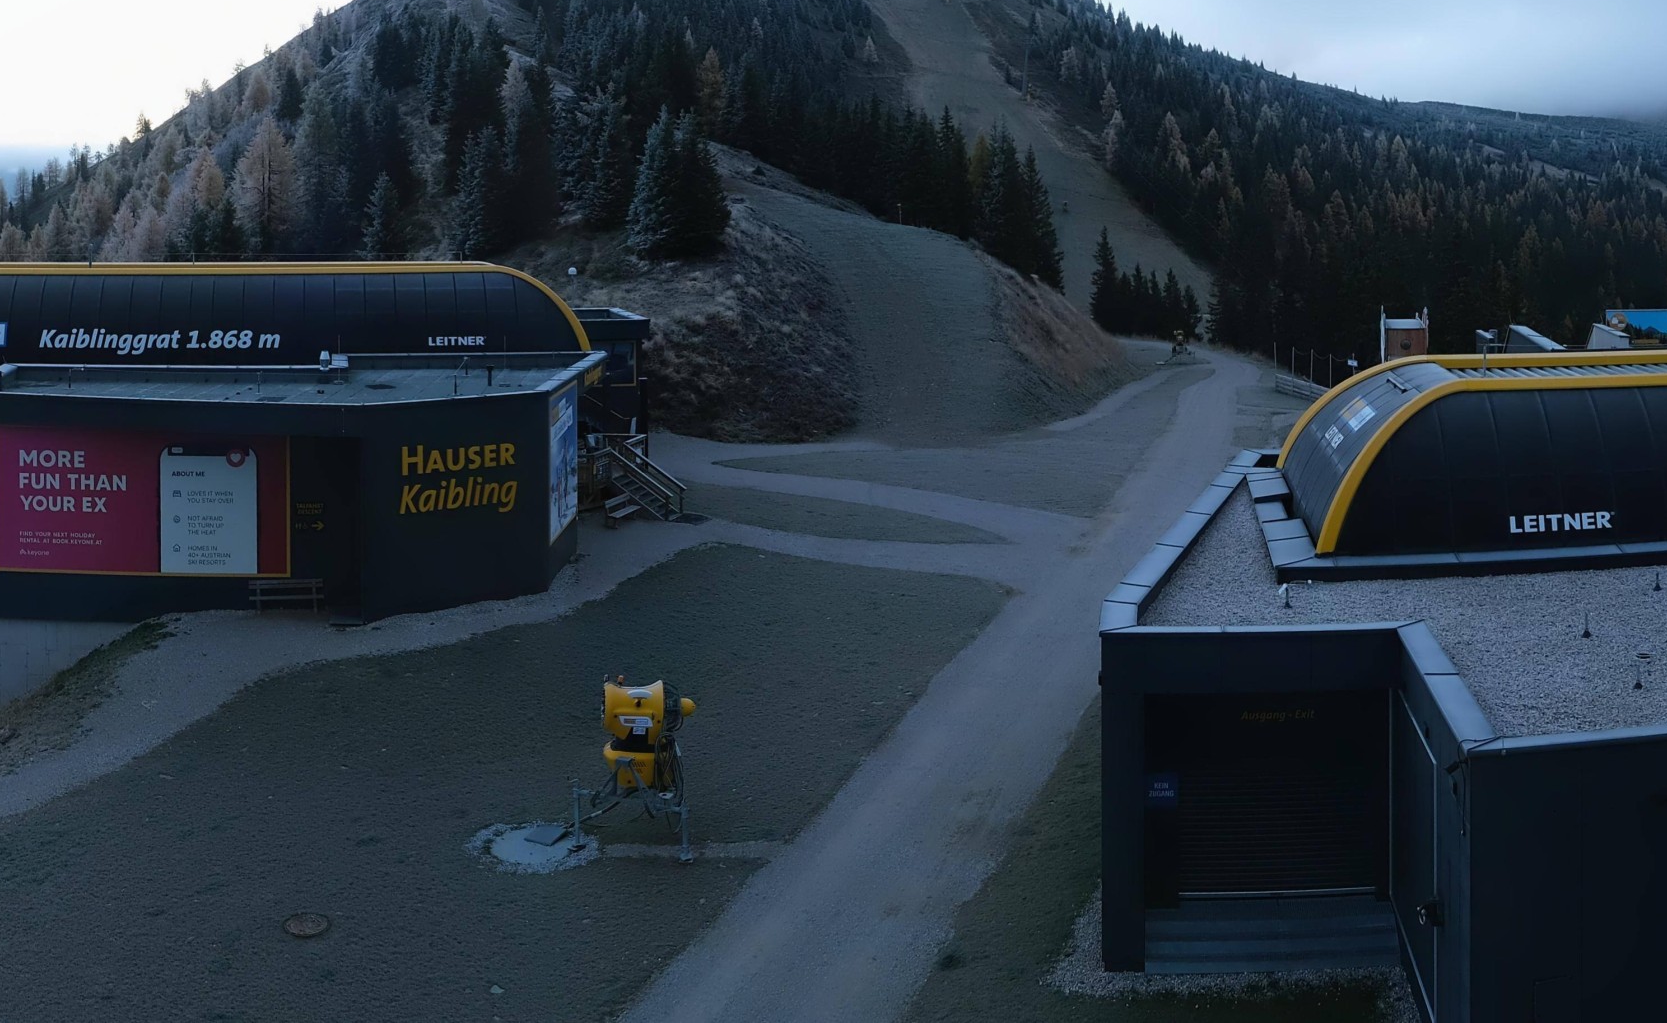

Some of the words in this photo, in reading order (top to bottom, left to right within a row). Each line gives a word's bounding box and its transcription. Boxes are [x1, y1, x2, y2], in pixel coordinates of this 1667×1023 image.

[38, 328, 181, 356] Kaiblinggrat
[186, 329, 254, 349] 1.868
[258, 333, 281, 349] m
[428, 336, 486, 346] LEITNER
[19, 449, 85, 468] MORE
[401, 443, 516, 476] HAUSER
[19, 472, 60, 490] FUN
[67, 473, 127, 491] THAN
[20, 495, 75, 512] YOUR
[82, 497, 107, 513] EX
[399, 477, 518, 515] Kaibling
[1509, 511, 1613, 533] LEITNER
[1240, 711, 1286, 722] Ausgang
[1295, 709, 1315, 719] Exit
